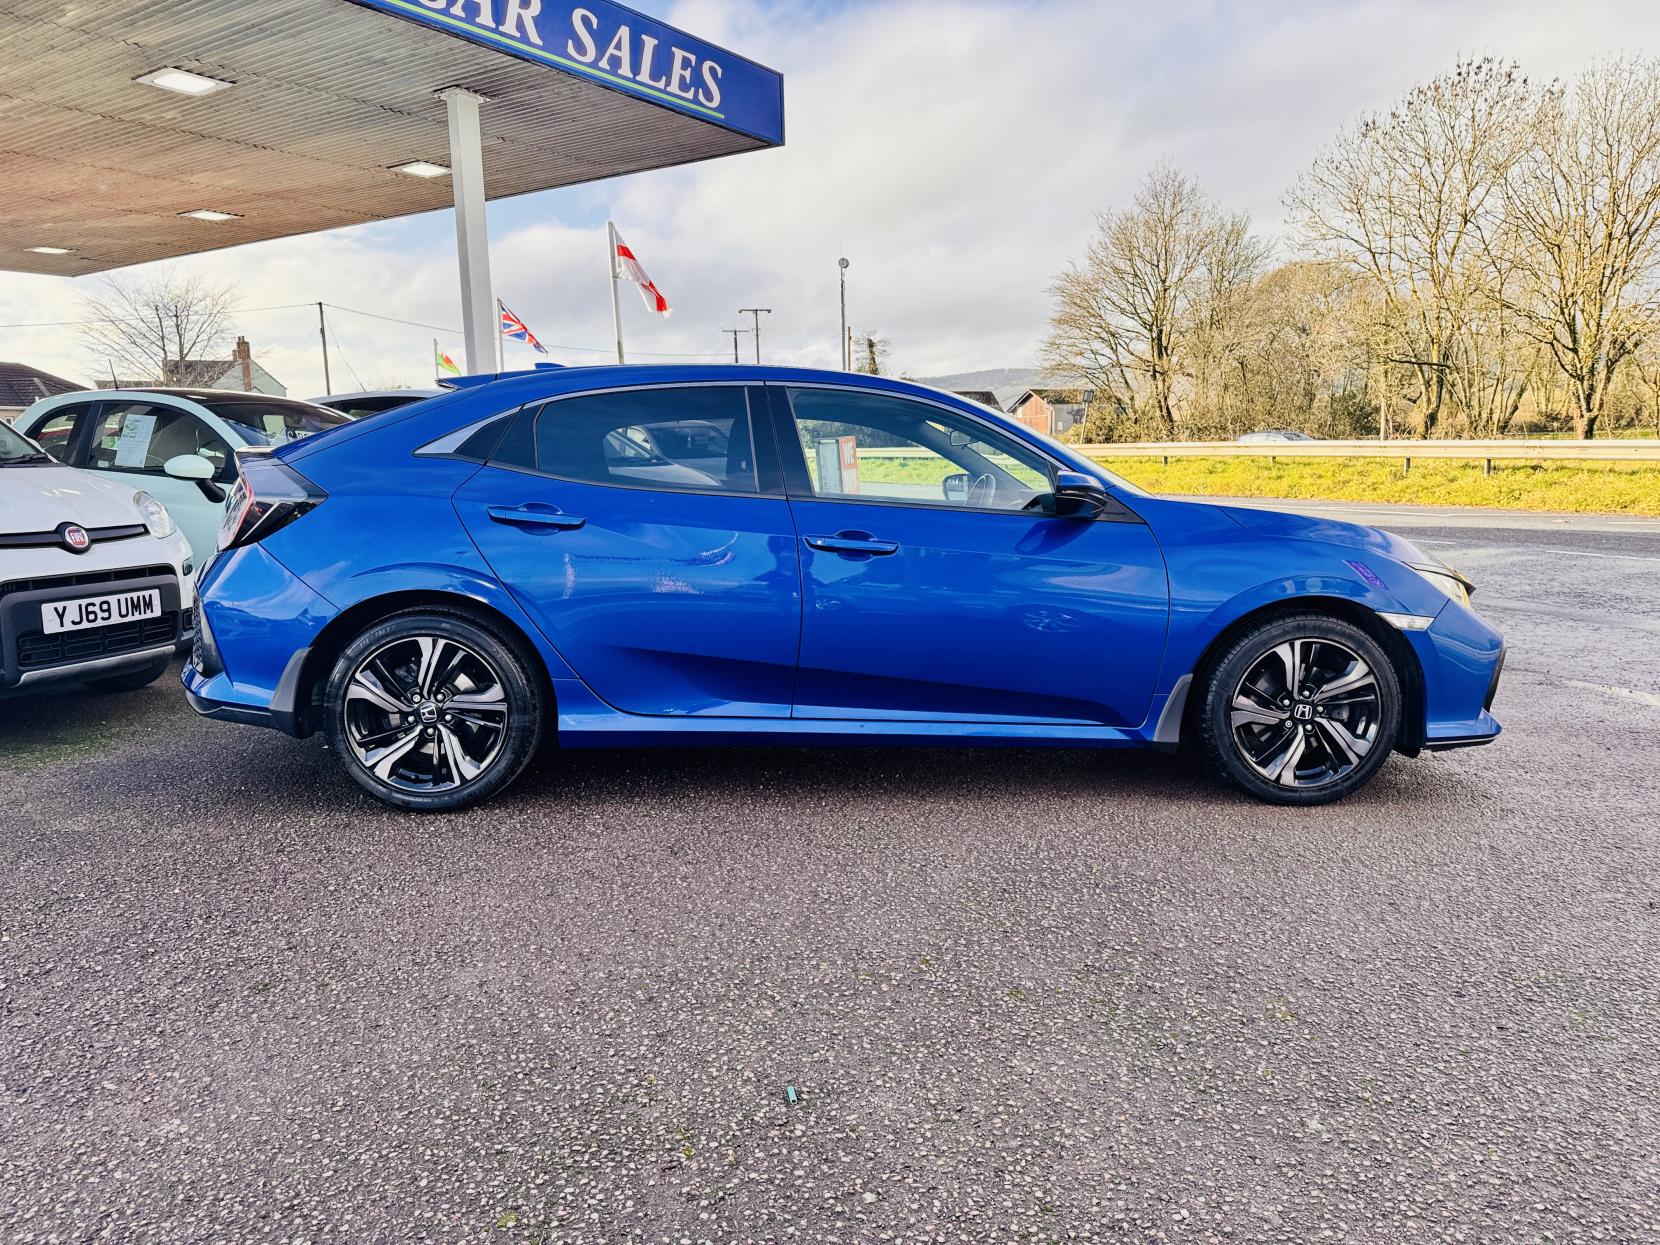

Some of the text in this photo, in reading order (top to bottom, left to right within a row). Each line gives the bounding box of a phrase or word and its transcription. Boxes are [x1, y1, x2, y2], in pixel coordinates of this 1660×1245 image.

[416, 0, 723, 109] AR SALES
[53, 593, 154, 628] YJ69 UMM
